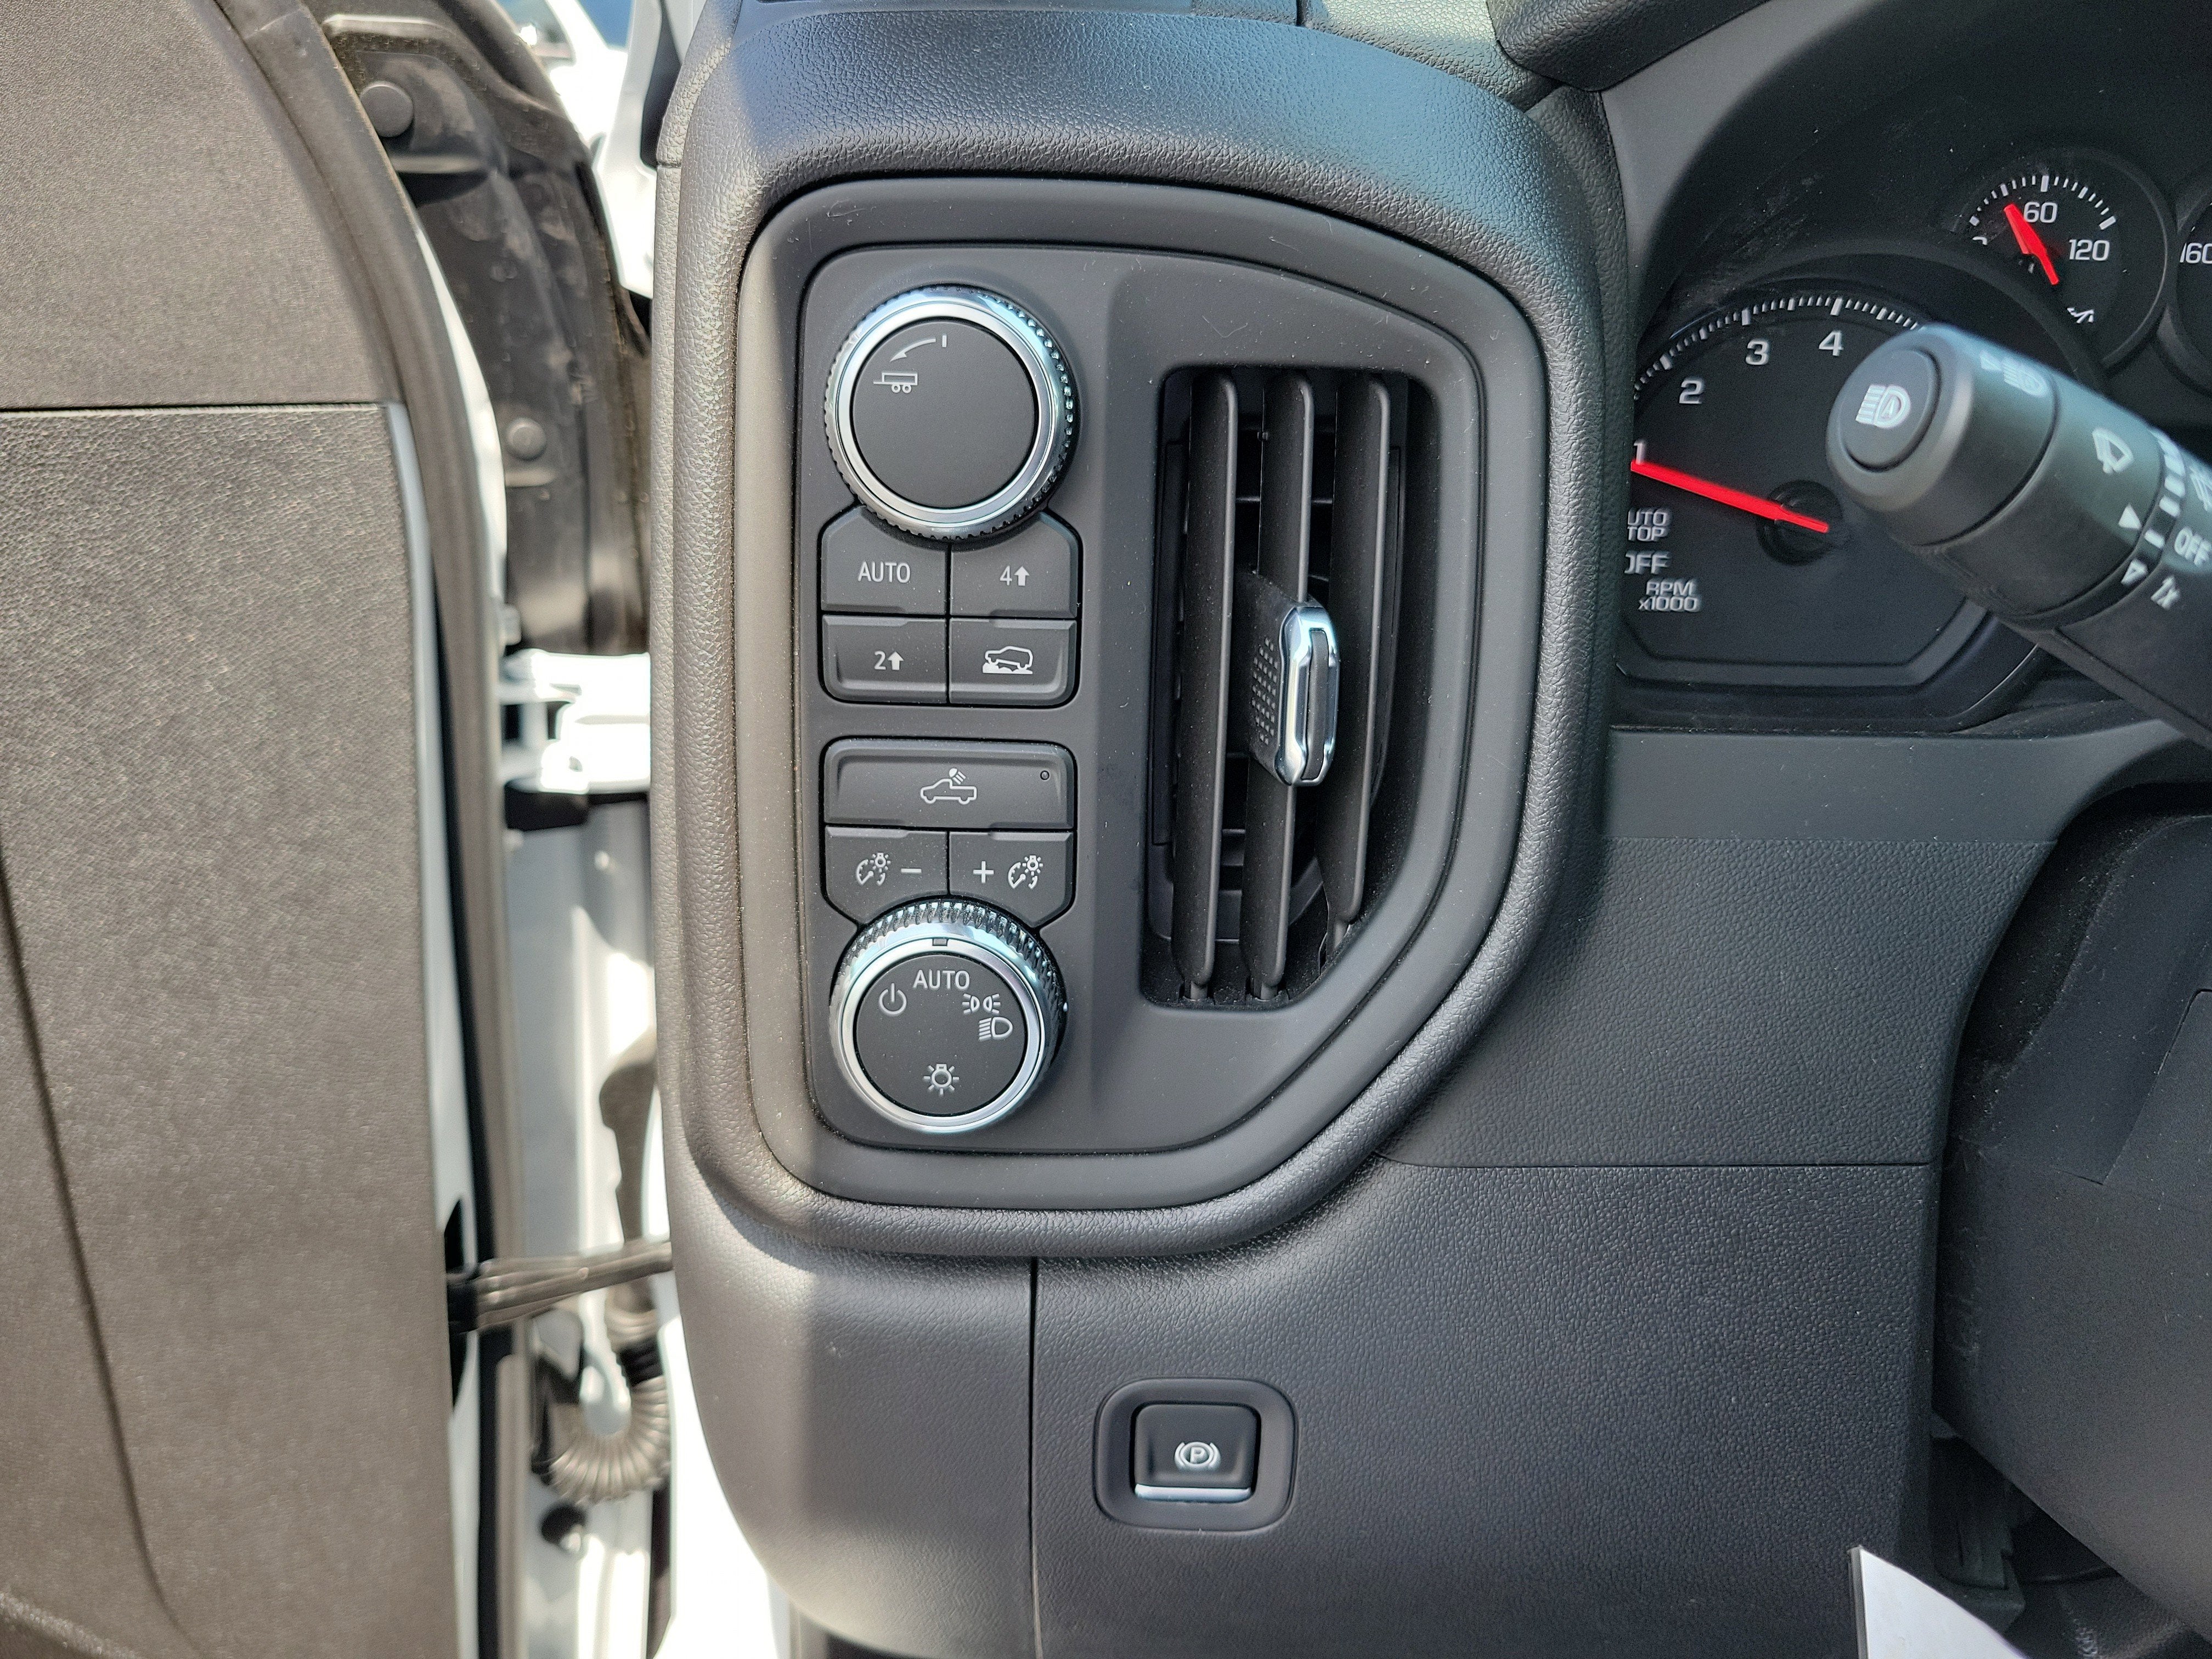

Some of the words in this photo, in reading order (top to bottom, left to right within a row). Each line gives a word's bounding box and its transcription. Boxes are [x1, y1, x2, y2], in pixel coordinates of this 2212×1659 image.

[2024, 202, 2058, 223] 60
[2069, 239, 2110, 261] 120
[1746, 338, 1769, 365] 3
[1818, 330, 1844, 357] 4
[1679, 377, 1705, 404] 2
[1633, 439, 1646, 465] 1
[1627, 508, 1671, 526] UTO
[1627, 526, 1668, 541] TOP
[2174, 527, 2211, 567] OFF
[857, 562, 911, 584] AUTO
[1000, 566, 1012, 585] 4
[1646, 578, 1700, 596] RPM
[1638, 596, 1701, 612] x1000
[874, 651, 886, 670] 2
[913, 970, 970, 990] AUTO
[1190, 1447, 1204, 1463] P
